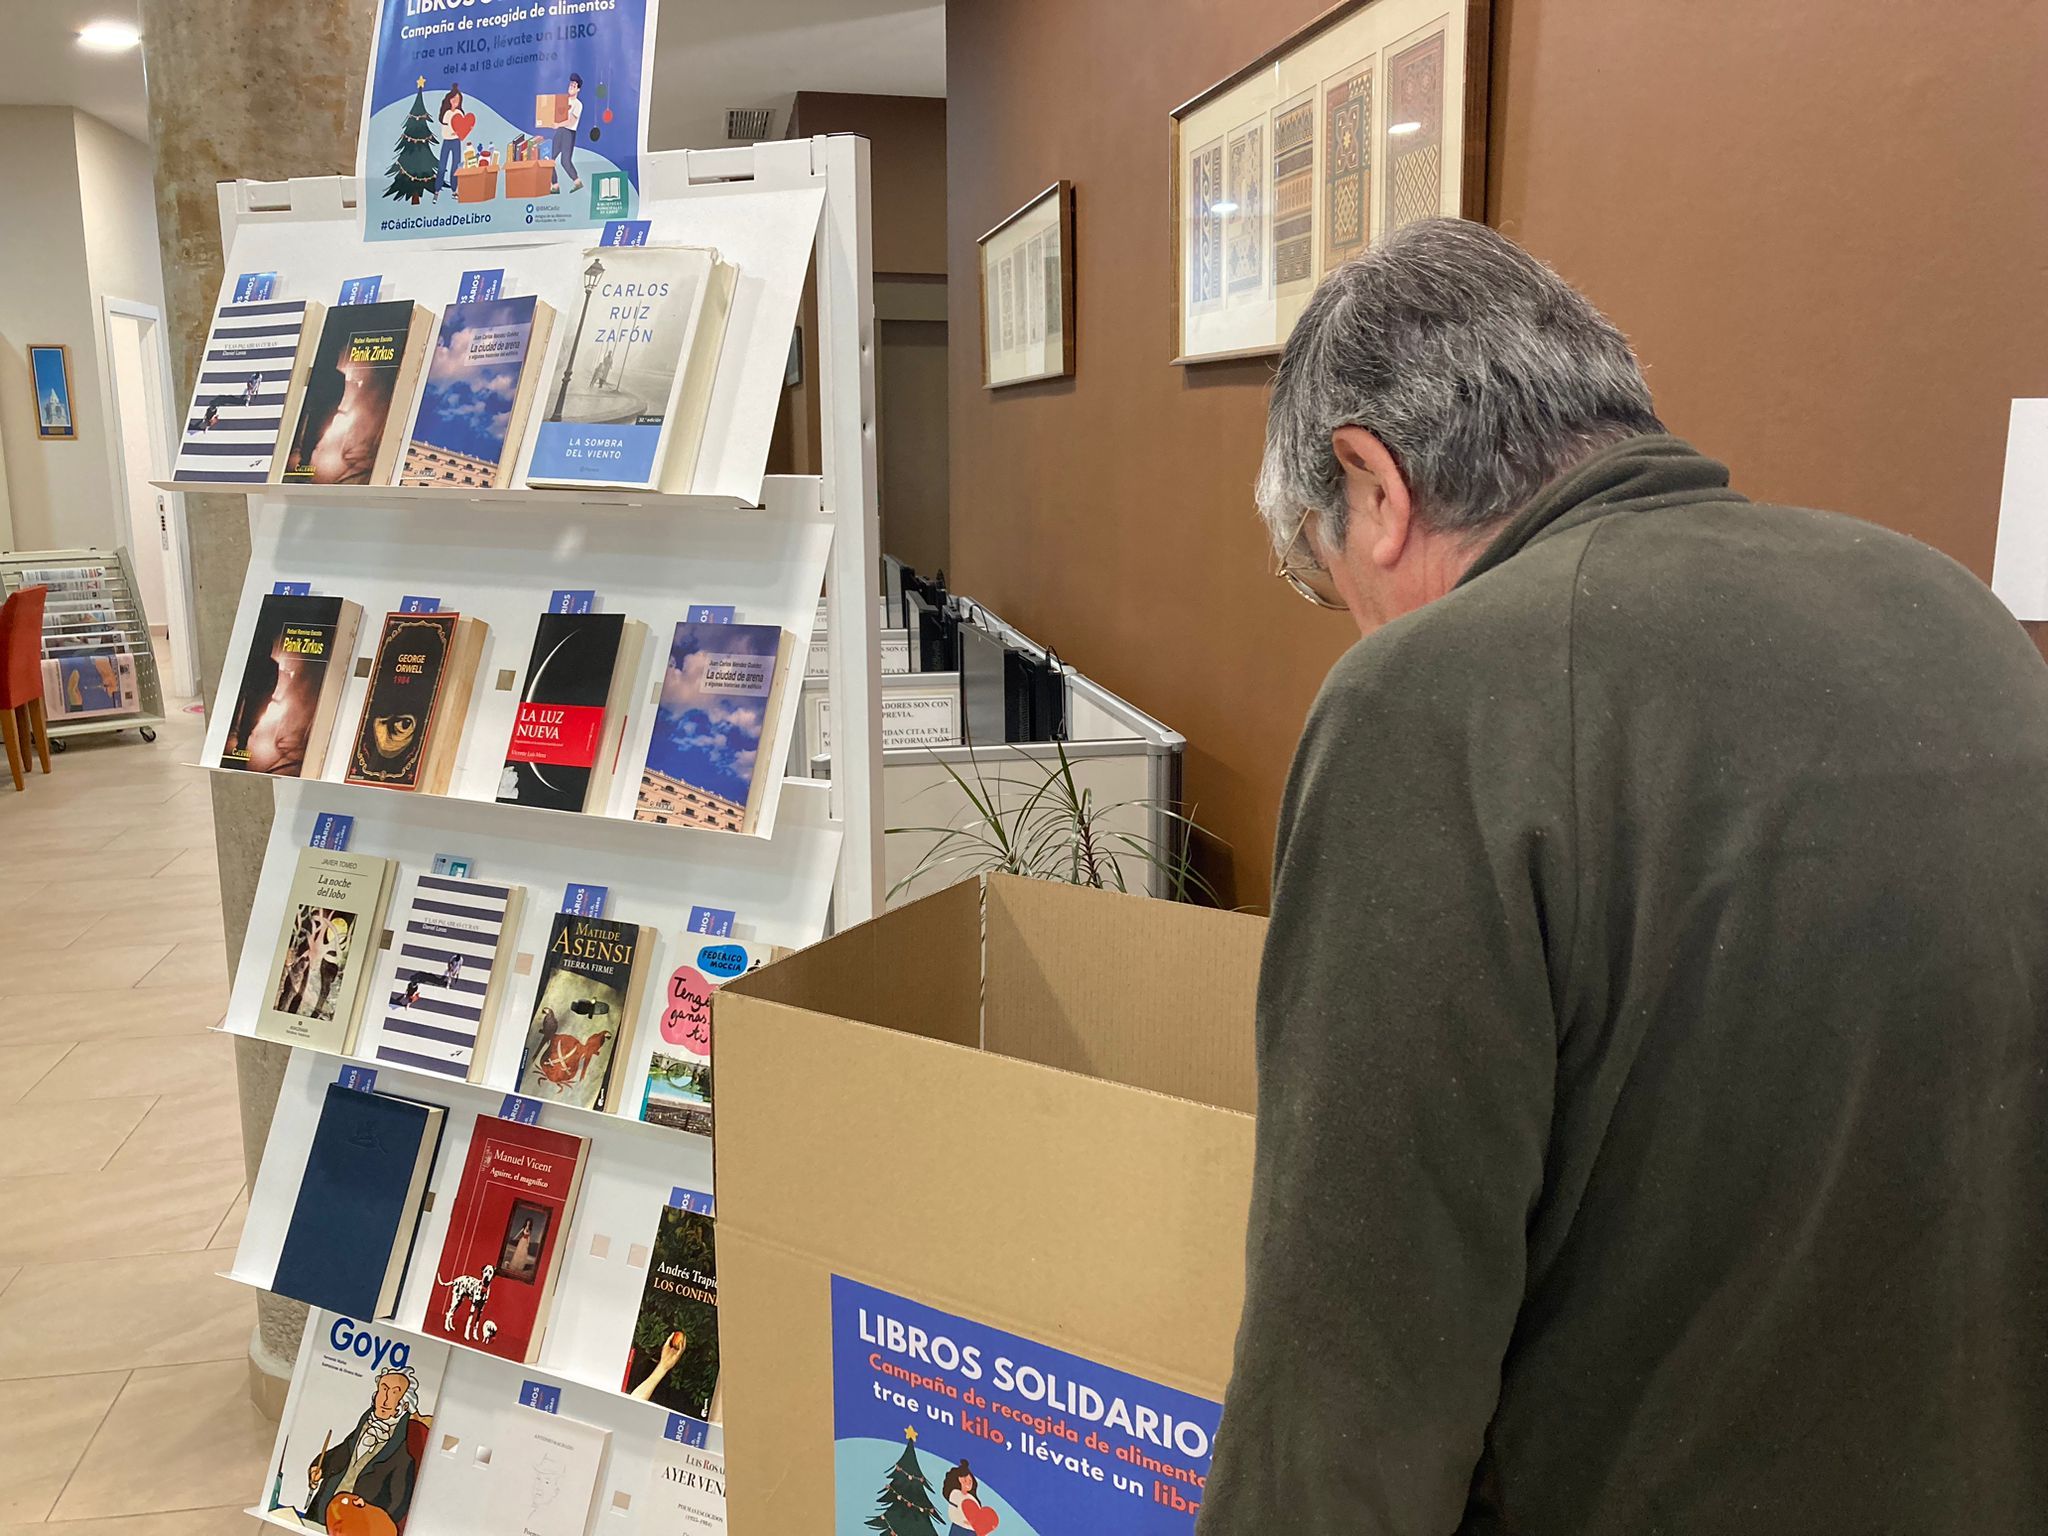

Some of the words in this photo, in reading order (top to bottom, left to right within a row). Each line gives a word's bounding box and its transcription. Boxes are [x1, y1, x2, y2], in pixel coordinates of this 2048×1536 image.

[400, 19, 454, 40] Campaña
[458, 16, 473, 30] de
[476, 6, 527, 27] recogida
[529, 2, 545, 19] de
[549, 0, 615, 16] alimentos
[439, 45, 453, 57] un
[457, 38, 491, 54] KILO,
[557, 22, 597, 41] LIBRO
[443, 63, 458, 75] del
[461, 62, 467, 73] 4
[469, 61, 479, 72] al
[482, 59, 492, 70] 18
[493, 57, 504, 68] de
[381, 213, 492, 230] #CádizCiudadDeLibro
[602, 283, 669, 297] CARLOS
[609, 306, 650, 320] RUIZ
[595, 326, 653, 342] ZAFÓN
[349, 346, 371, 362] Pánik
[370, 346, 394, 361] Zirkus
[470, 343, 478, 353] La
[478, 341, 496, 352] ciudad
[497, 341, 504, 351] de
[504, 341, 520, 350] arena
[569, 438, 581, 446] LA
[584, 439, 623, 448] SOMBRA
[566, 449, 583, 458] DEL
[587, 450, 621, 459] VIENTO
[283, 637, 302, 653] Pánik
[301, 638, 324, 654] Zirkus
[398, 654, 427, 664] GEORGE
[395, 664, 423, 674] ORWELL
[706, 670, 714, 680] La
[715, 670, 736, 681] ciudad
[737, 671, 746, 682] de
[746, 673, 764, 683] arena
[913, 701, 929, 709] SON
[931, 700, 949, 708] CON
[521, 708, 536, 722] LA
[540, 710, 565, 724] LUZ
[516, 724, 560, 739] NUEVA
[906, 728, 925, 736] CITA
[891, 735, 949, 745] INFORMACIÓN
[339, 860, 357, 870] TOMEO
[318, 874, 327, 885] La
[328, 877, 352, 888] noche
[317, 887, 329, 897] del
[328, 888, 346, 900] lobo
[575, 922, 620, 941] MATILDE
[551, 926, 633, 964] ASENSI
[702, 950, 742, 962] FEDERICO
[563, 959, 590, 971] TIERRA
[591, 963, 614, 975] FIRME
[710, 961, 741, 971] MOCCIA
[668, 1009, 707, 1028] ganas
[686, 1024, 708, 1043] ti
[494, 1149, 525, 1167] Manuel
[526, 1157, 552, 1173] Vicent
[490, 1167, 513, 1179] Aguirre,
[513, 1173, 520, 1181] el
[657, 1261, 690, 1280] Andrés
[653, 1277, 674, 1293] LOS
[675, 1284, 719, 1306] CONFIN
[330, 1317, 410, 1371] Goya
[859, 1308, 982, 1380] LIBROS
[992, 1357, 1218, 1460] SOLIDARIO
[869, 1353, 958, 1399] Campaña
[963, 1388, 987, 1409] de
[992, 1401, 1079, 1444] recogida
[1084, 1432, 1109, 1454] de
[1116, 1445, 1208, 1488] alimento
[873, 1381, 920, 1413] trae
[926, 1404, 954, 1426] un
[961, 1410, 1012, 1451] kilo,
[1021, 1432, 1105, 1482] llévate
[1113, 1473, 1144, 1497] un
[1152, 1480, 1200, 1515] libr
[661, 1466, 696, 1488] AYER
[698, 1474, 726, 1498] VEN
